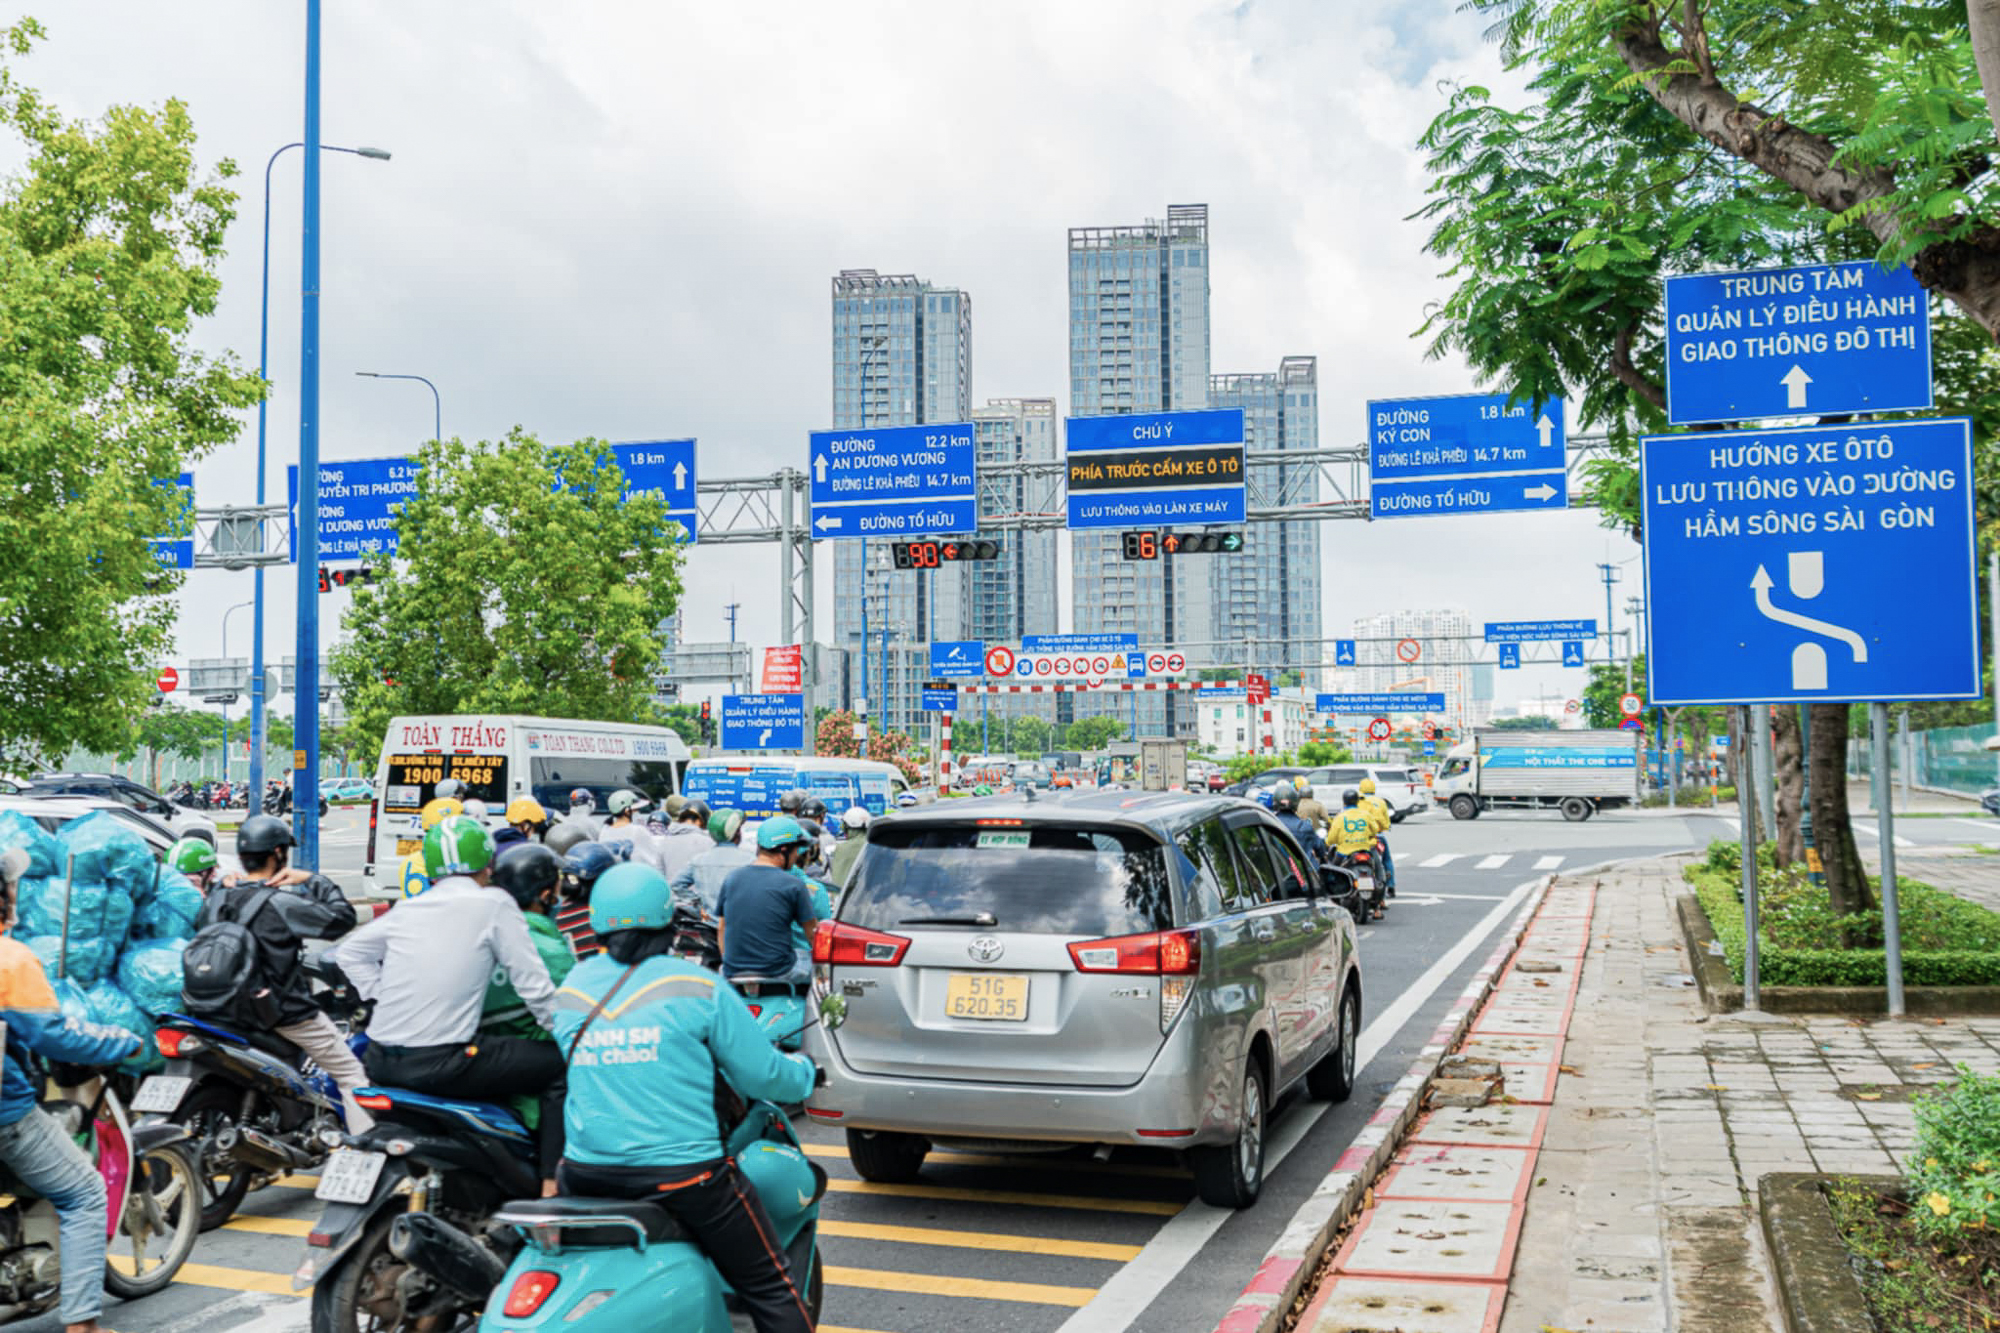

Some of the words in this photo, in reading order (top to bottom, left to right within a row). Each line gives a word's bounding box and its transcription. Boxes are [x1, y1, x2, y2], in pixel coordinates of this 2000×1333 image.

[1720, 273, 1804, 298] TRUNG
[1810, 267, 1864, 290] TÂM
[1676, 305, 1742, 333] QUẢN
[1749, 303, 1777, 328] LÝ
[1783, 295, 1838, 325] ĐIỀU
[1846, 295, 1916, 319] HÀNH
[1681, 340, 1737, 362] GIAO
[1743, 331, 1828, 358] THÔNG
[1835, 326, 1869, 352] ĐÔ
[1875, 326, 1915, 350] THỊ
[1377, 406, 1429, 426] ĐƯỜNG
[1480, 405, 1498, 420] 1.8
[1133, 422, 1161, 440] CHÚ
[1164, 421, 1174, 438] Ý
[1400, 429, 1430, 442] CON
[831, 437, 875, 453] ĐƯỜNG
[925, 435, 947, 449] 12.2
[950, 434, 970, 447] km
[1710, 441, 1799, 469] HƯỚNG
[1806, 442, 1838, 463] XE
[1845, 436, 1893, 461] ÔTÔ
[630, 453, 644, 465] 1.8
[647, 453, 664, 464] km
[832, 458, 850, 470] AN
[854, 454, 898, 469] DƯƠNG
[901, 452, 946, 466] VƯƠNG
[1378, 451, 1408, 468] ĐƯỜNG
[1410, 450, 1421, 466] LÊ
[1422, 448, 1441, 465] KHẢ
[1473, 448, 1500, 462] 14.7
[1503, 447, 1526, 460] km
[389, 467, 404, 479] 6.2
[1071, 463, 1103, 481] PHÍA
[1106, 459, 1150, 479] TRƯỚC
[1153, 457, 1183, 476] CẤM
[1186, 460, 1204, 475] XE
[1207, 457, 1217, 474] Ô
[1220, 456, 1238, 473] TÔ
[352, 484, 369, 497] TRI
[832, 475, 861, 492] ĐƯỜNG
[863, 474, 874, 490] LÊ
[876, 473, 892, 489] KHẢ
[926, 473, 948, 487] 14.7
[951, 473, 971, 486] km
[1656, 483, 1706, 504] LƯU
[1713, 476, 1798, 501] THÔNG
[1805, 471, 1855, 497] VÀO
[1081, 505, 1102, 518] LƯU
[1105, 503, 1140, 517] THÔNG
[1142, 501, 1162, 515] VÀO
[1165, 500, 1186, 515] LÀN
[1189, 502, 1202, 514] XE
[1205, 499, 1228, 513] MÁY
[1380, 491, 1431, 511] ĐƯỜNG
[1435, 487, 1454, 506] TỐ
[1458, 489, 1490, 506] HỮU
[326, 519, 364, 533] DƯƠNG
[860, 512, 904, 530] ĐƯỜNG
[908, 510, 924, 527] TỐ
[927, 511, 955, 527] HỮU
[1685, 509, 1740, 538] HẦM
[1747, 508, 1816, 535] SÔNG
[1823, 506, 1865, 531] SÀI
[1880, 502, 1935, 529] GÒN
[909, 542, 939, 568] 90
[1140, 533, 1155, 559] 6
[402, 722, 441, 746] TOÀN
[451, 720, 506, 748] THẮNG
[403, 767, 442, 783] 1900
[451, 767, 493, 784] 6968
[1344, 816, 1367, 832] be
[970, 978, 1004, 995] 51G
[954, 998, 1016, 1016] 620.35
[628, 1026, 660, 1044] SM
